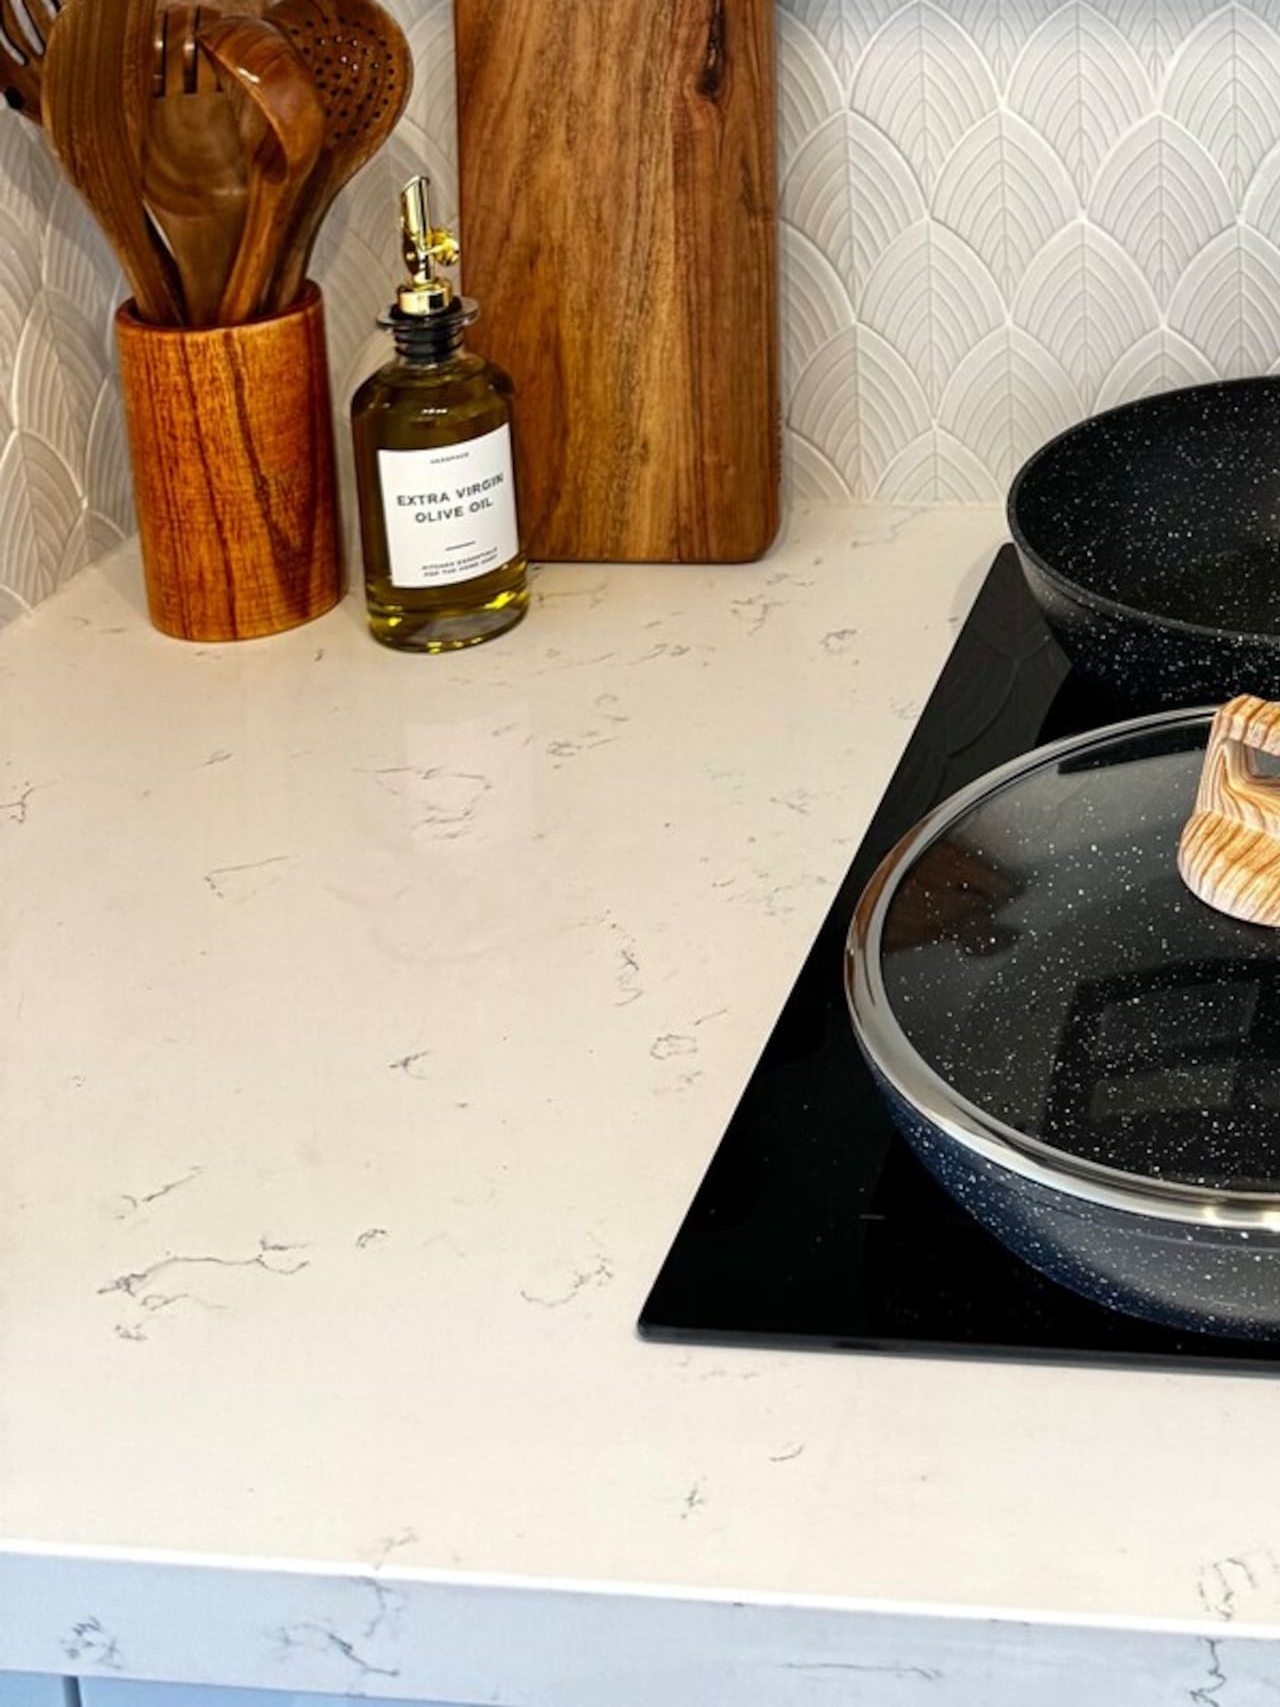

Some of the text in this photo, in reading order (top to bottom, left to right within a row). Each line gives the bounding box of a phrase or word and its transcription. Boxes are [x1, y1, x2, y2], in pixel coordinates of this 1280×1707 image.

[396, 472, 504, 507] EXTRA VIRGIN
[414, 497, 493, 524] OLIVE OIL
